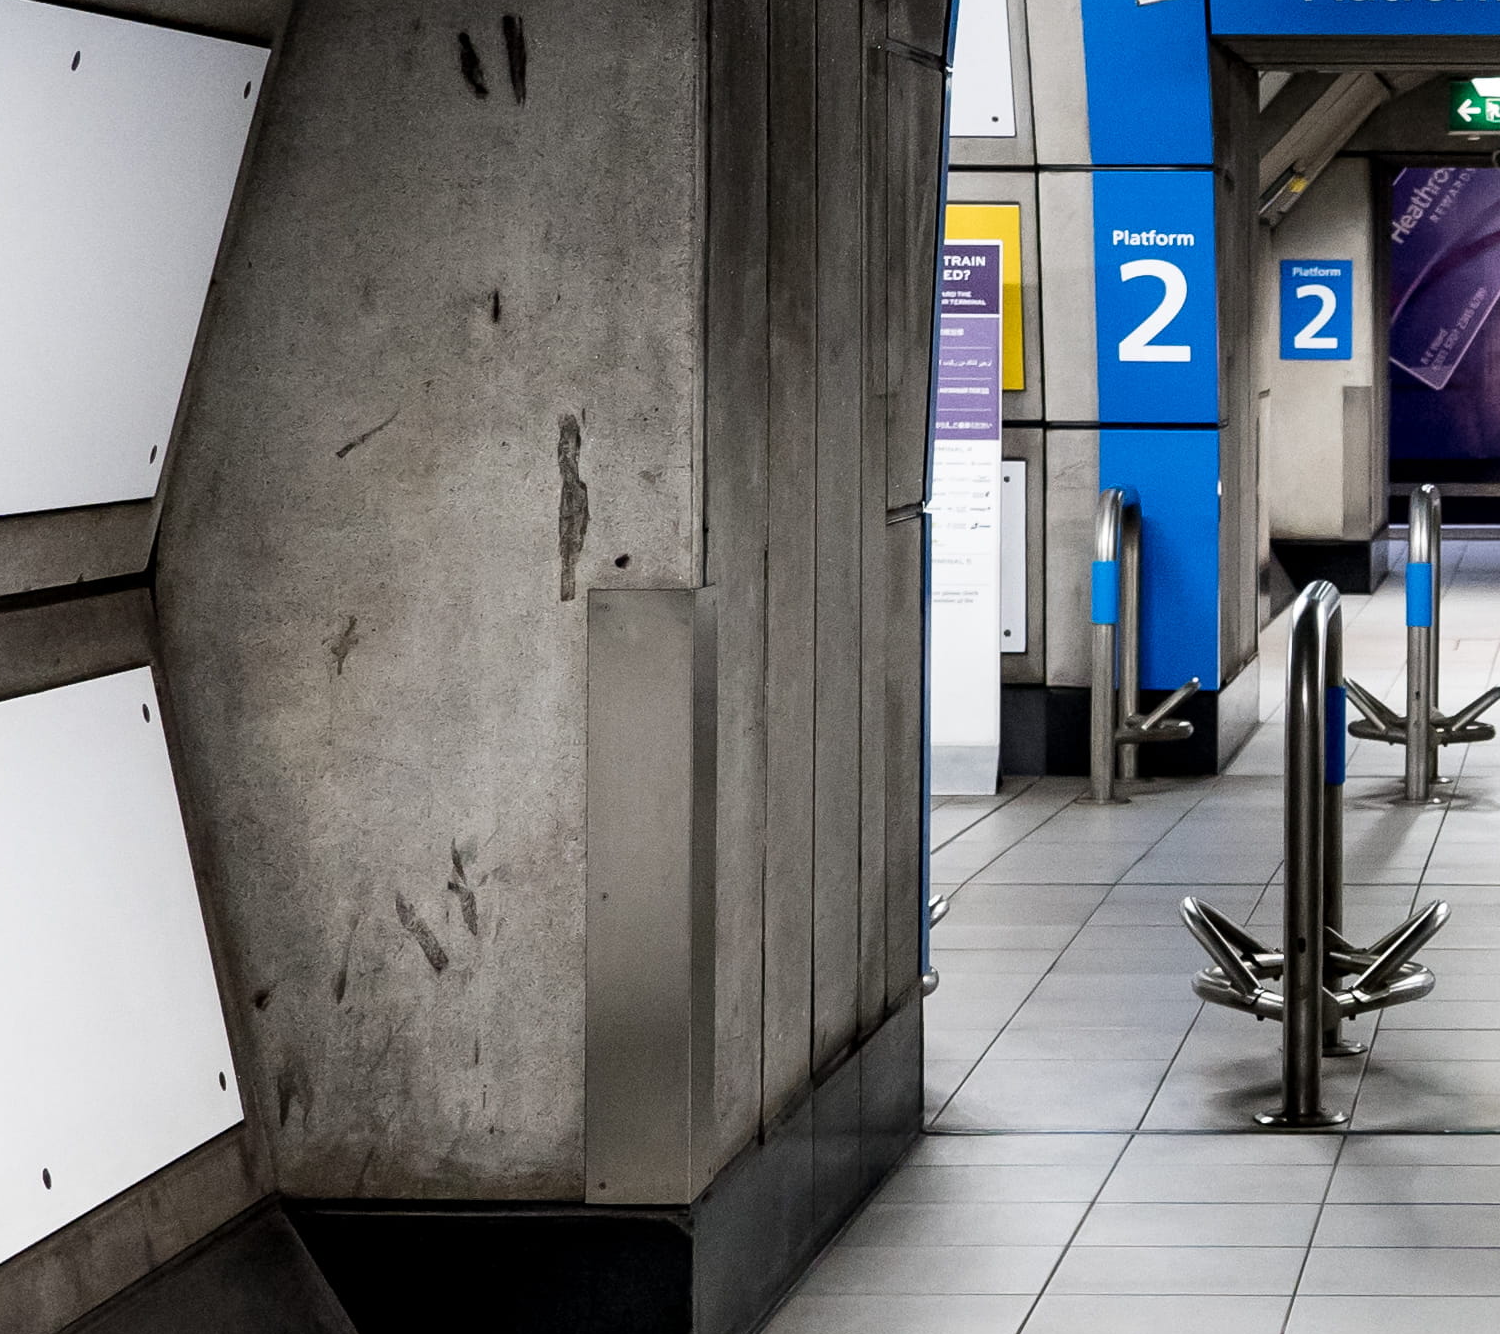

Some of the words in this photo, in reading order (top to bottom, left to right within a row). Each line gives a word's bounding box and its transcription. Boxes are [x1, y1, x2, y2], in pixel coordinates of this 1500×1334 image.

[1391, 166, 1456, 244] Heathro
[1113, 230, 1194, 246] Platform
[943, 255, 986, 267] TRAIN
[1292, 267, 1341, 277] Platform
[1119, 259, 1191, 362] 2
[1294, 284, 1338, 349] 2
